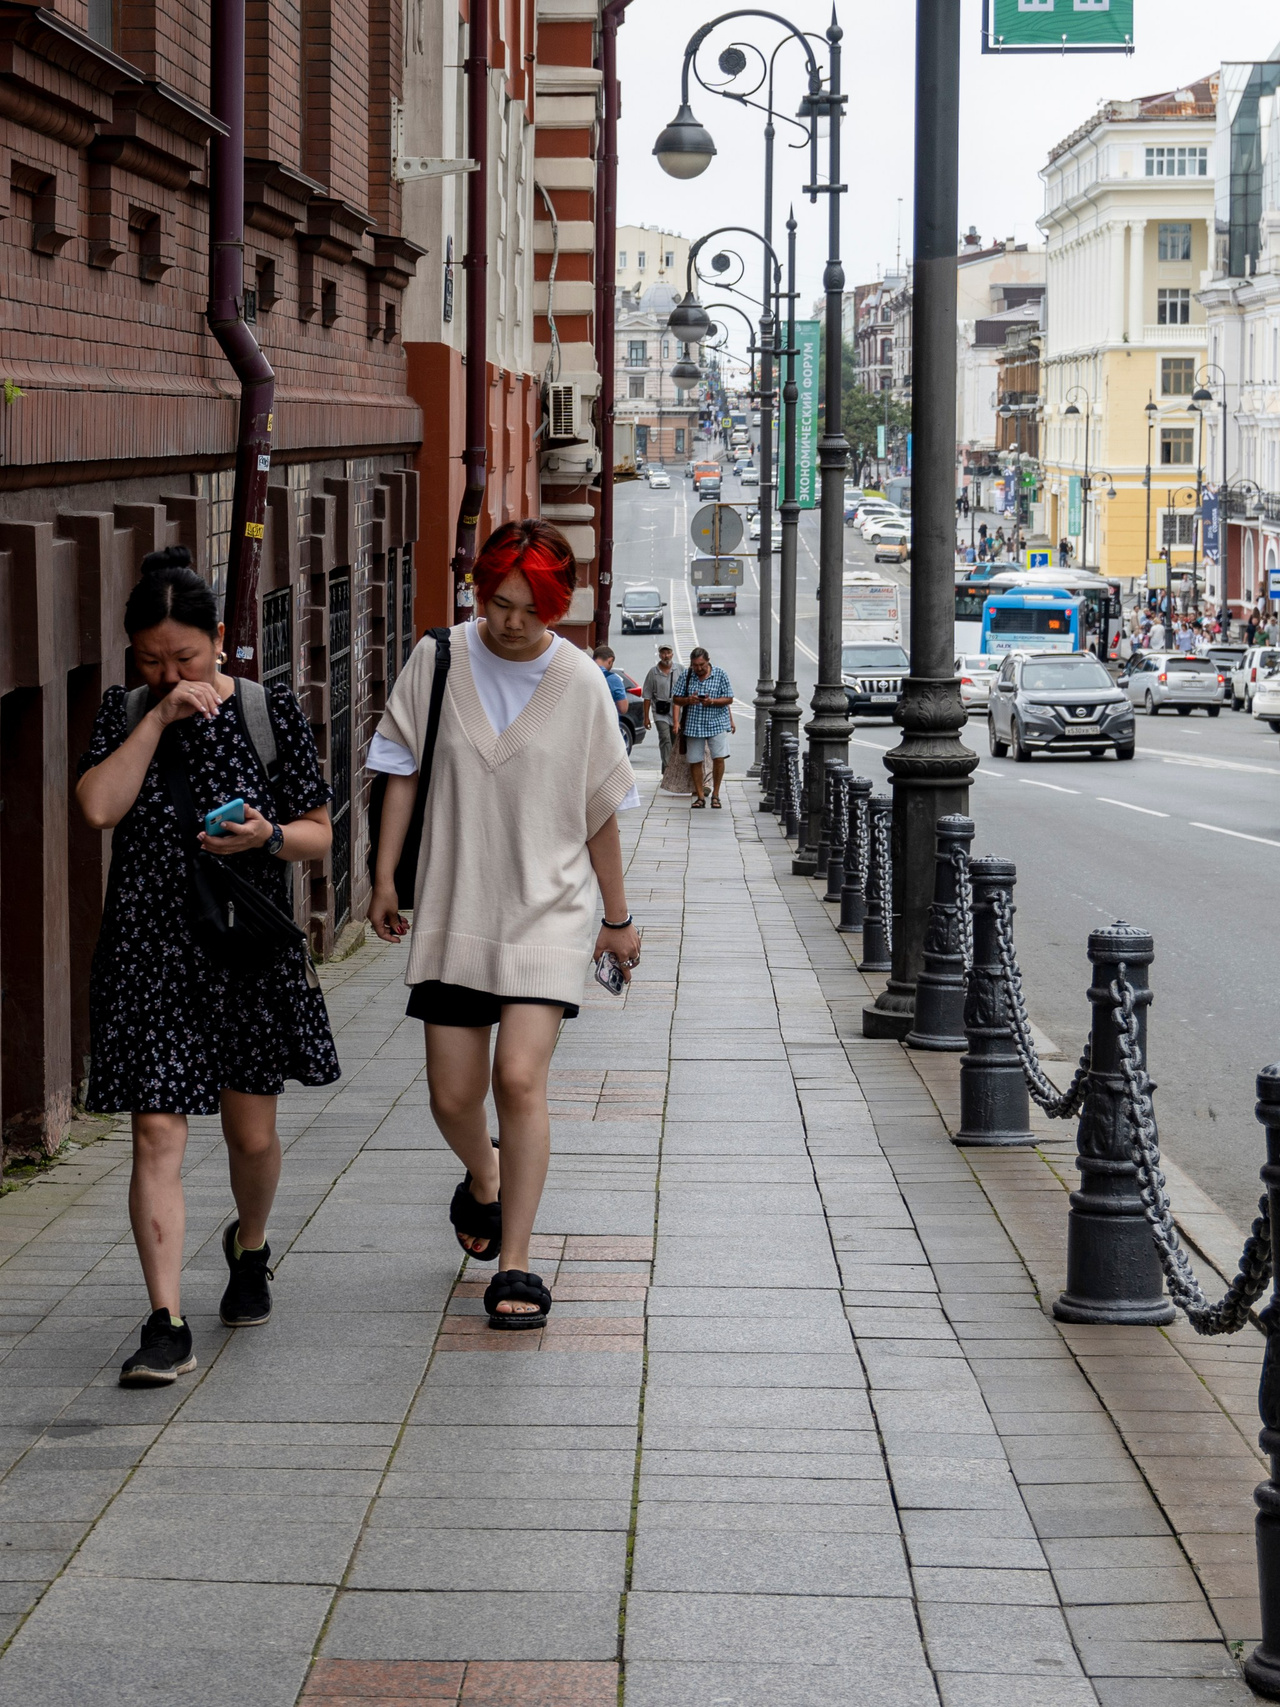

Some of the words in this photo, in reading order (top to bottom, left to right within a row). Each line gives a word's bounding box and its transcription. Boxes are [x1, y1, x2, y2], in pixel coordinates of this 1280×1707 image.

[802, 342, 814, 389] ФОРУМ
[800, 391, 812, 501] ЭКОНОМИЧЕСКИЙ
[888, 609, 897, 618] 13
